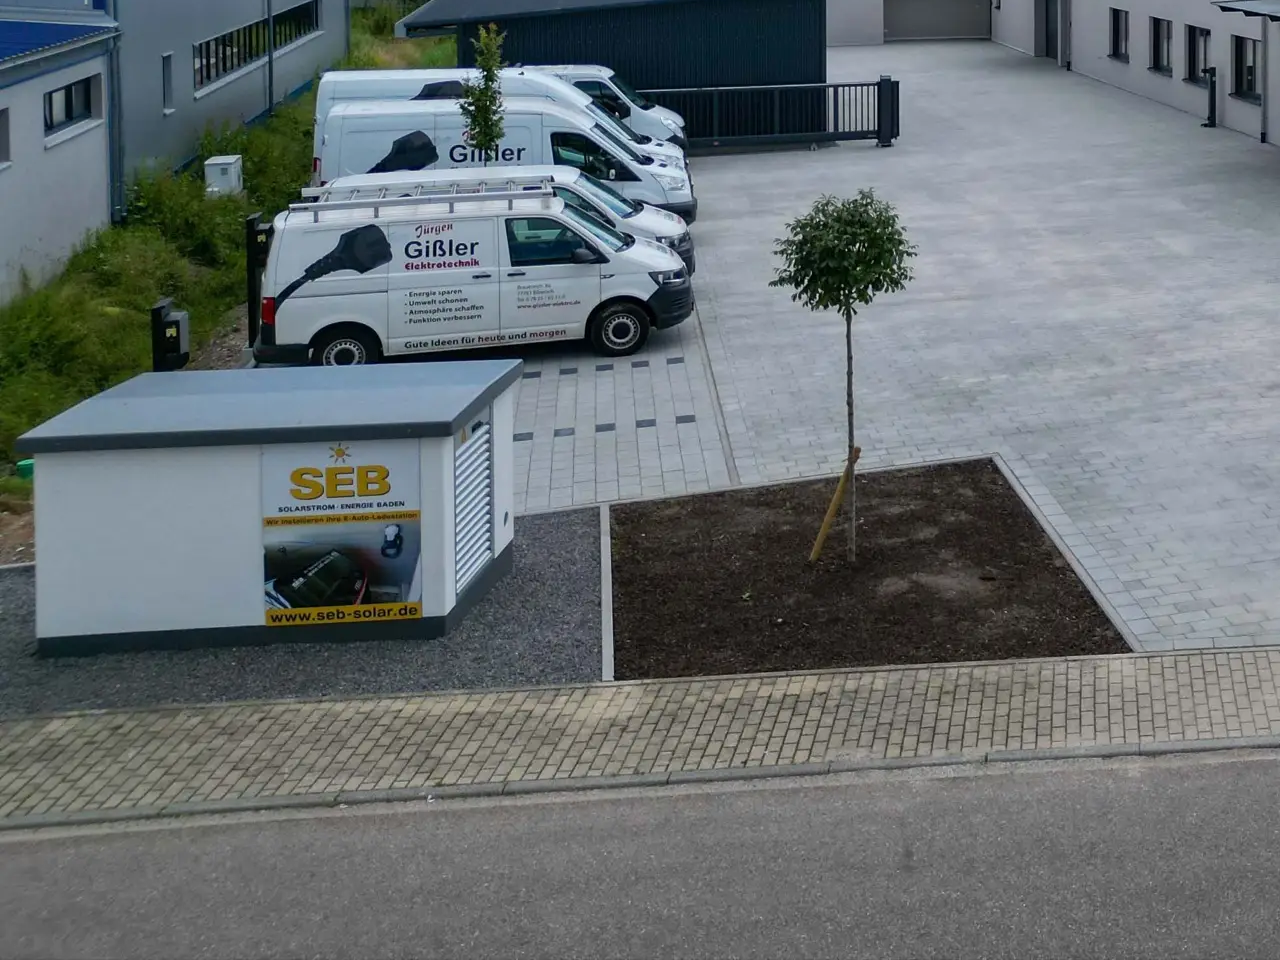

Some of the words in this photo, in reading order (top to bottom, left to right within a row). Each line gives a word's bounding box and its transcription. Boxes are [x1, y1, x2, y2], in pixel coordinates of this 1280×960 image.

[415, 223, 454, 239] Jürgen
[404, 239, 480, 259] Gißler
[404, 258, 480, 271] Elektrotechnik
[409, 307, 453, 315] Atmosphäre
[404, 341, 429, 349] Gute
[431, 339, 459, 347] Ideen
[478, 334, 506, 343] heute
[508, 332, 527, 340] und
[529, 329, 567, 338] morgen
[289, 464, 391, 501] SEB
[278, 504, 335, 513] SOLARSTROM
[340, 502, 374, 510] ENERGIE
[270, 605, 418, 623] www.seb-solar.de
